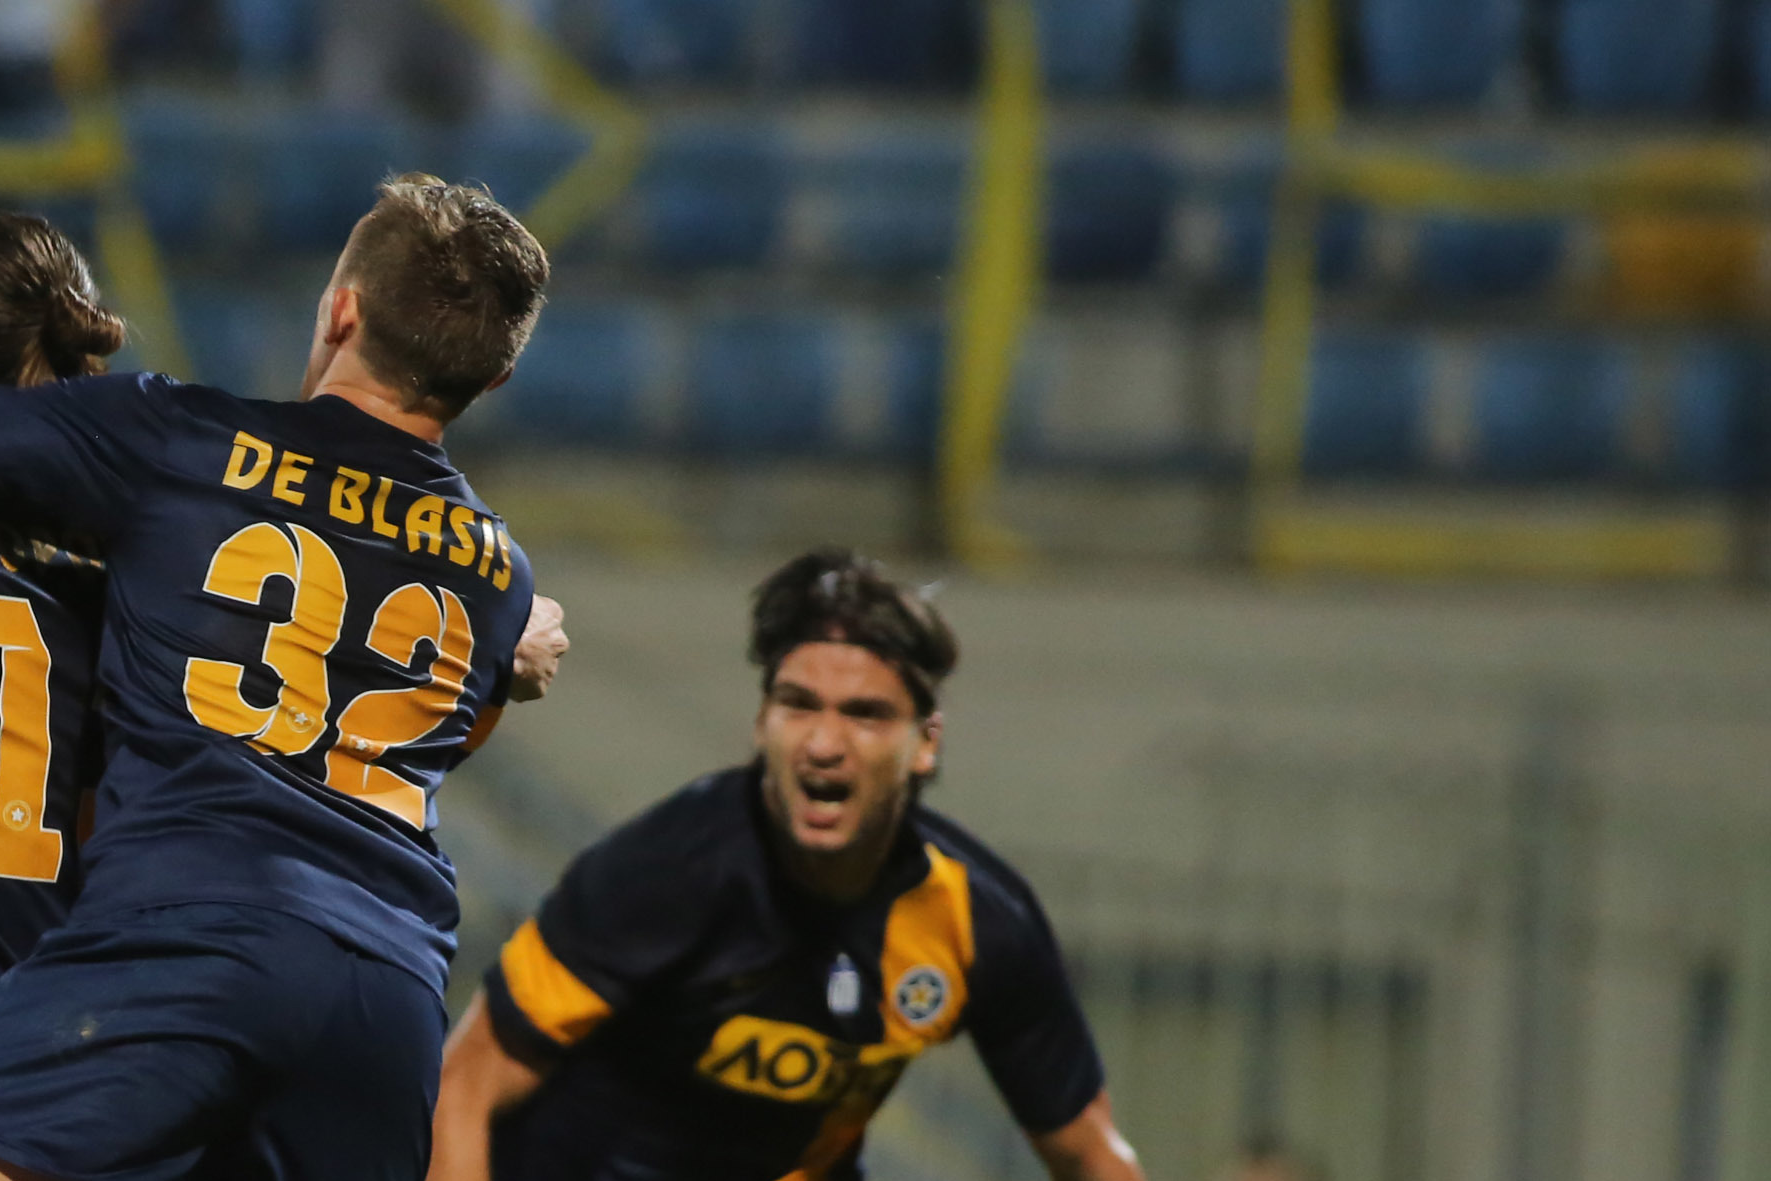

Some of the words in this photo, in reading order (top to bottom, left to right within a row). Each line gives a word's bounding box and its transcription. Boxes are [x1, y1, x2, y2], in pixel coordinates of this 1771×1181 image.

[221, 429, 315, 507] DE
[327, 464, 512, 592] BLASIS
[182, 521, 476, 832] 32
